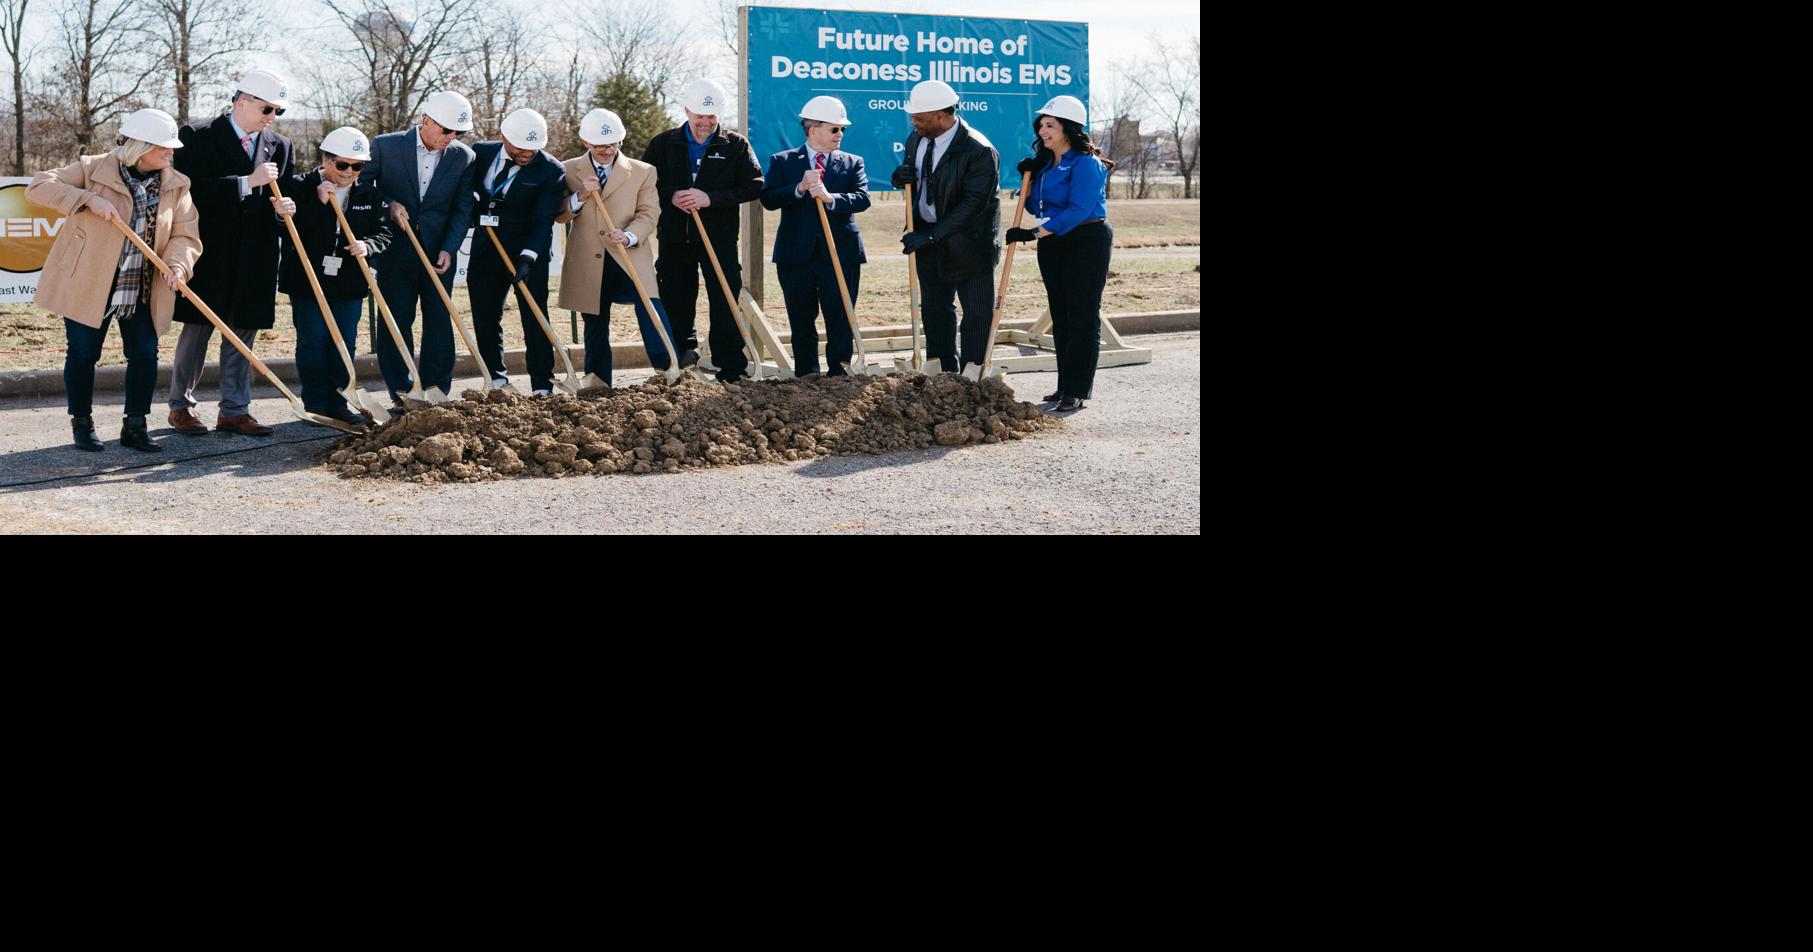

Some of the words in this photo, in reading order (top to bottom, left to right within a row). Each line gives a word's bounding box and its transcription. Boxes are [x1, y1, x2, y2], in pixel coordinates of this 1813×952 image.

[818, 27, 910, 52] Future
[917, 31, 994, 55] Home
[1000, 35, 1028, 56] of
[771, 55, 922, 81] Deaconess
[929, 60, 1013, 84] Illinois
[1019, 63, 1072, 86] EMS
